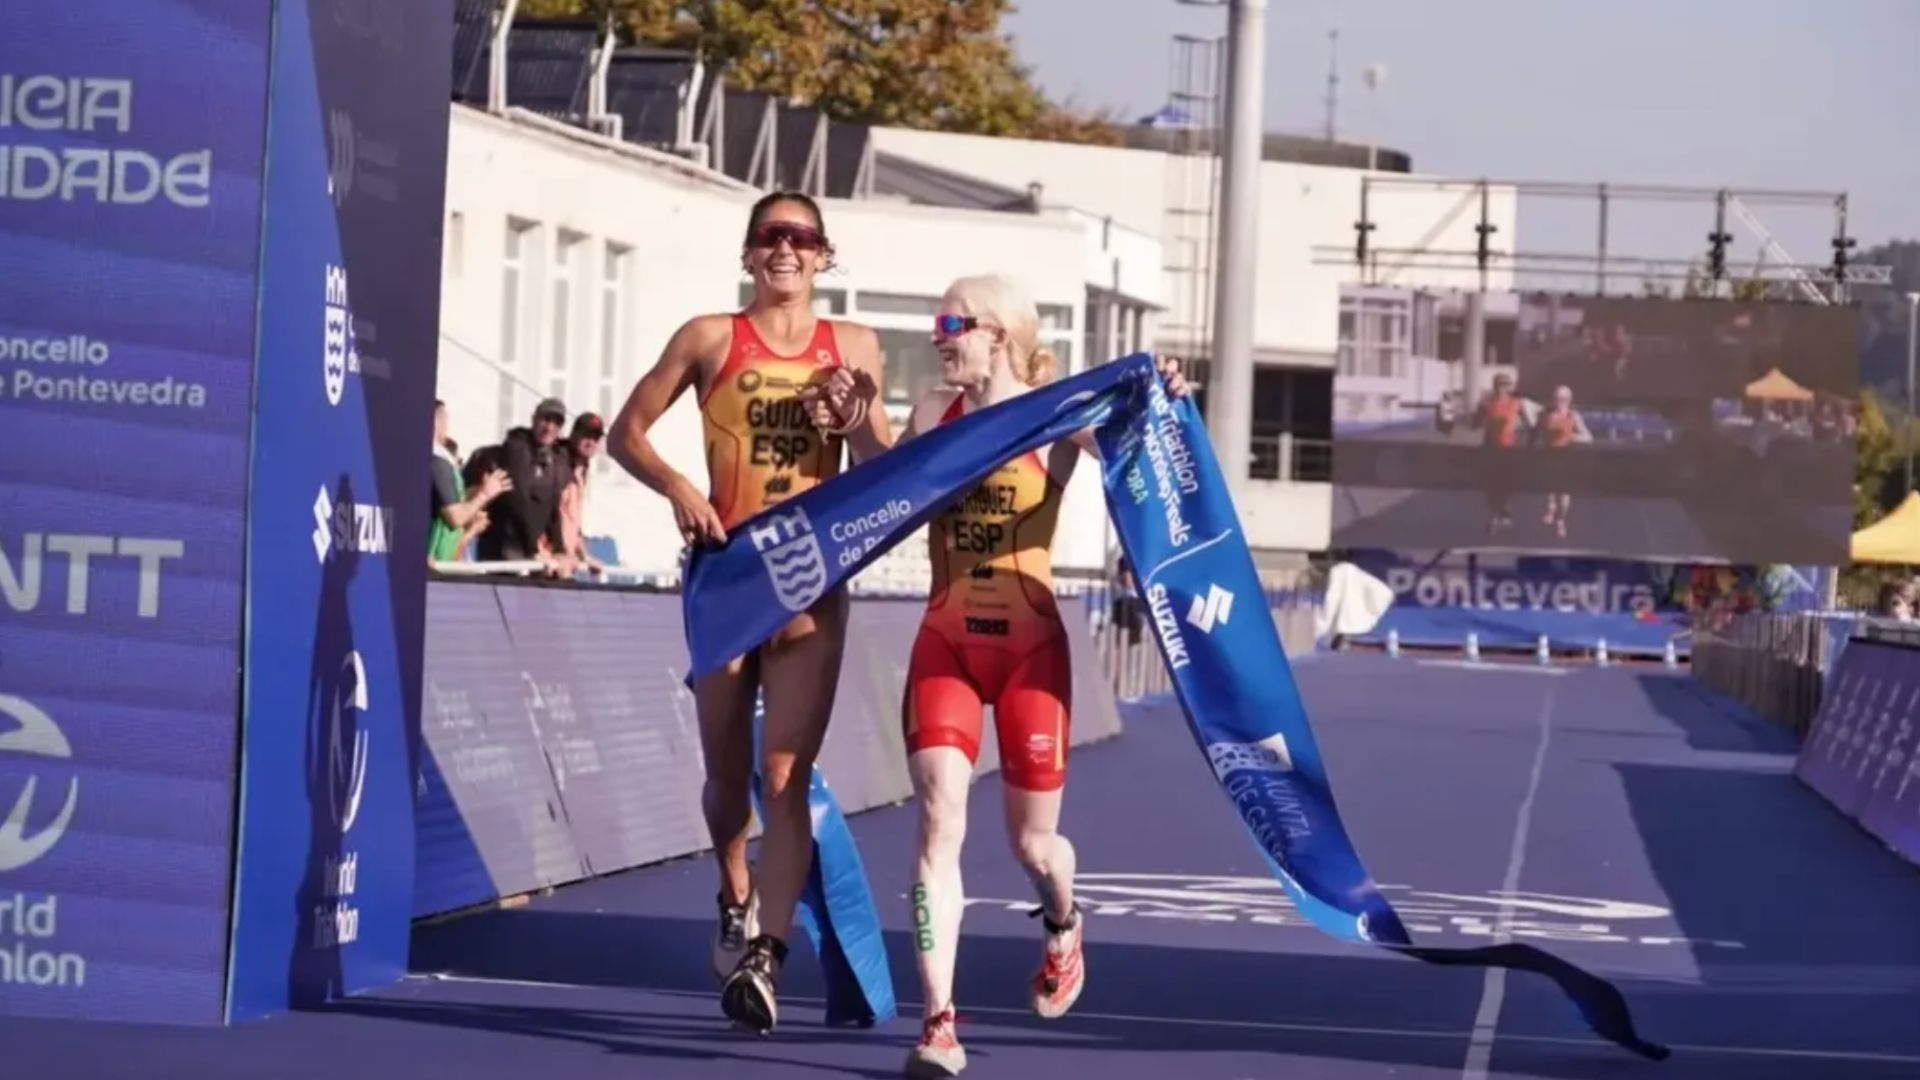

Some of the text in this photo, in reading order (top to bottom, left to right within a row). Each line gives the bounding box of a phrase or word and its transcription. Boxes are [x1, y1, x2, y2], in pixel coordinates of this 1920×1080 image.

[14, 369, 206, 408] Pontevedra
[746, 396, 815, 430] GUID
[750, 434, 809, 470] ESP
[830, 499, 911, 542] Concello
[955, 521, 1003, 554] ESP
[839, 546, 863, 567] de
[1387, 569, 1657, 618] Pontevedra
[1146, 582, 1190, 670] SUZUKI
[1261, 775, 1312, 838] XUNTA
[911, 881, 935, 952] 606
